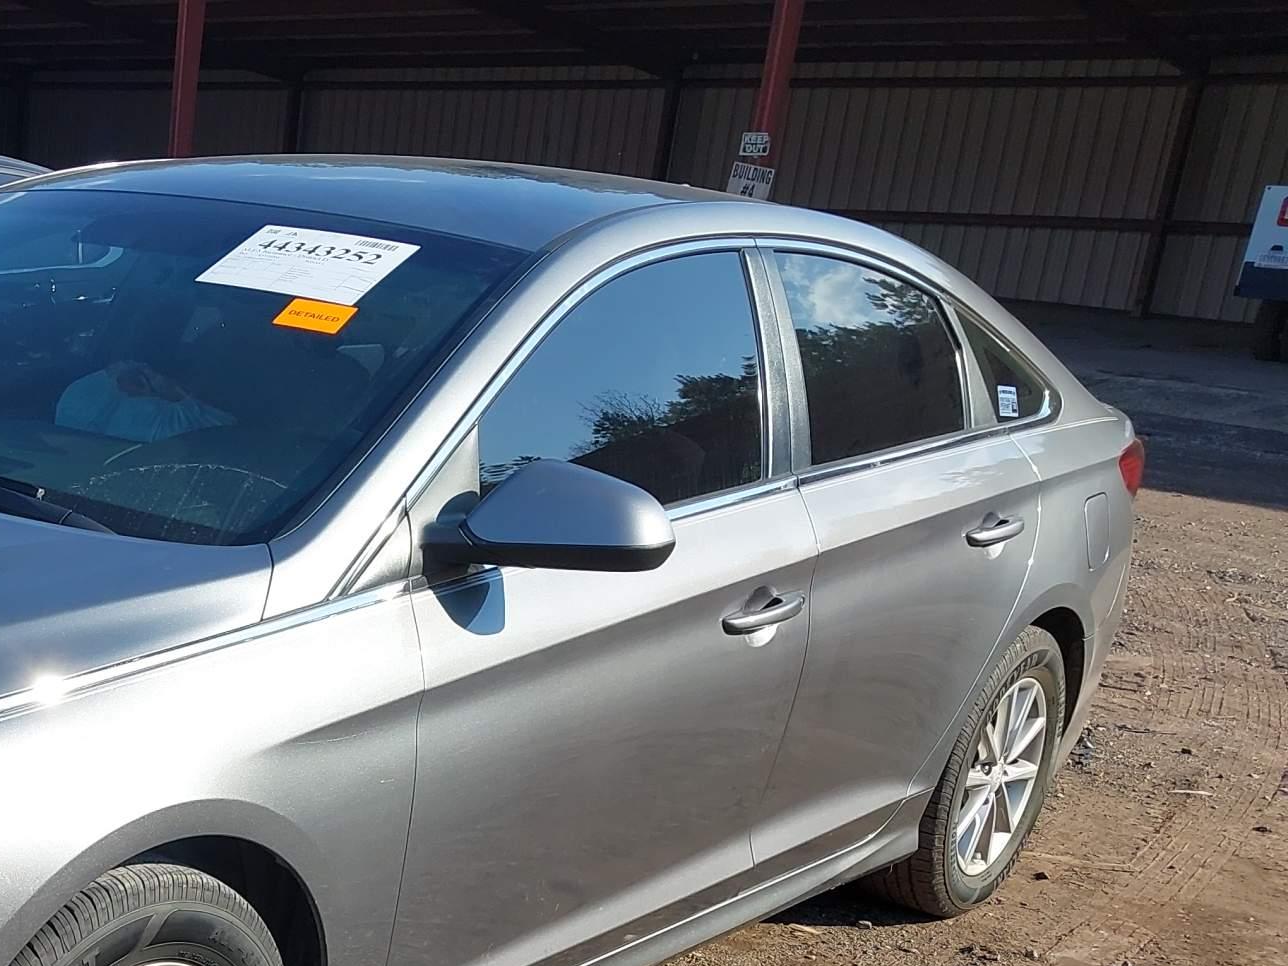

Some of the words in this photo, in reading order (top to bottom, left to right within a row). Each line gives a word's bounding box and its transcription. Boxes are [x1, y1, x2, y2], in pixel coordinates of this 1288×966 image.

[744, 135, 769, 144] KEEP
[745, 144, 766, 153] OUT
[732, 163, 773, 185] BUILDING
[740, 183, 756, 198] #4
[258, 239, 383, 266] 44343252
[287, 308, 341, 324] DETAILED
